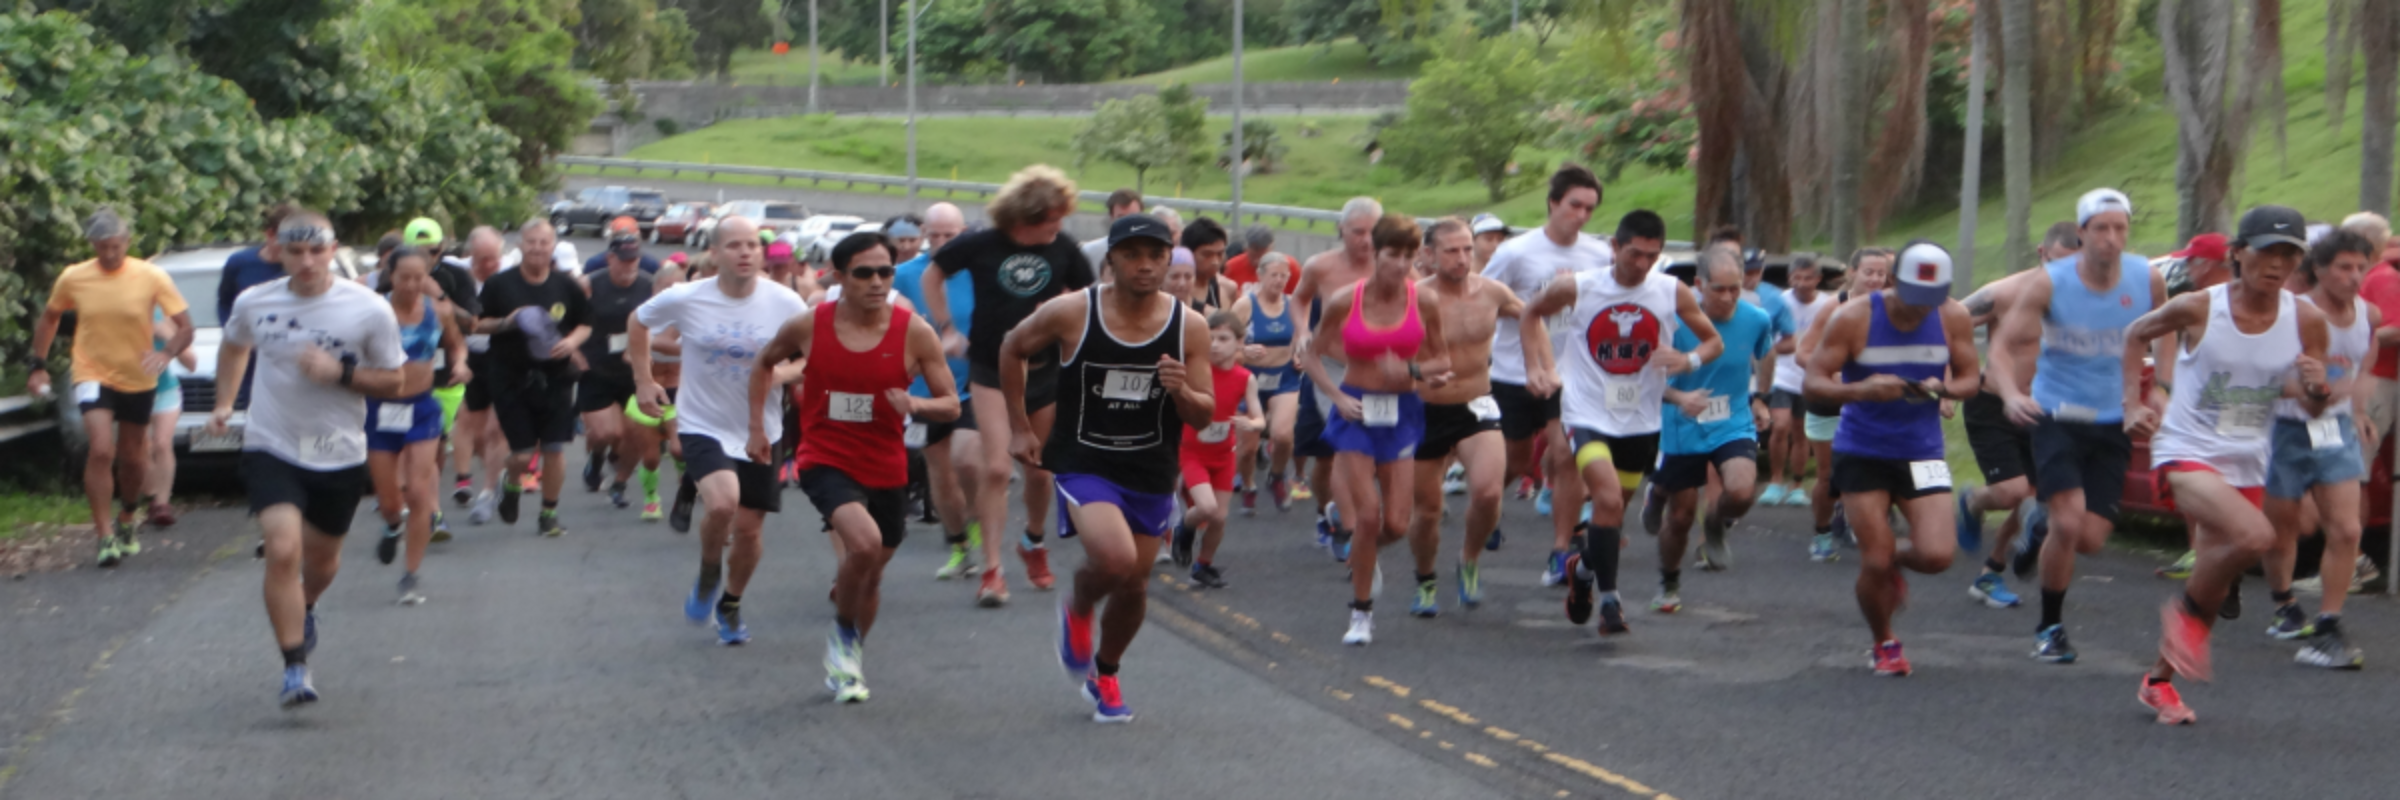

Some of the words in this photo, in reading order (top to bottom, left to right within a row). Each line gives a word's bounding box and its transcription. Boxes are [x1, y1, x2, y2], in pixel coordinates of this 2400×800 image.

[1119, 375, 1152, 393] 107
[844, 397, 873, 415] 123
[1107, 401, 1120, 410] AT
[1123, 401, 1142, 410] ALL
